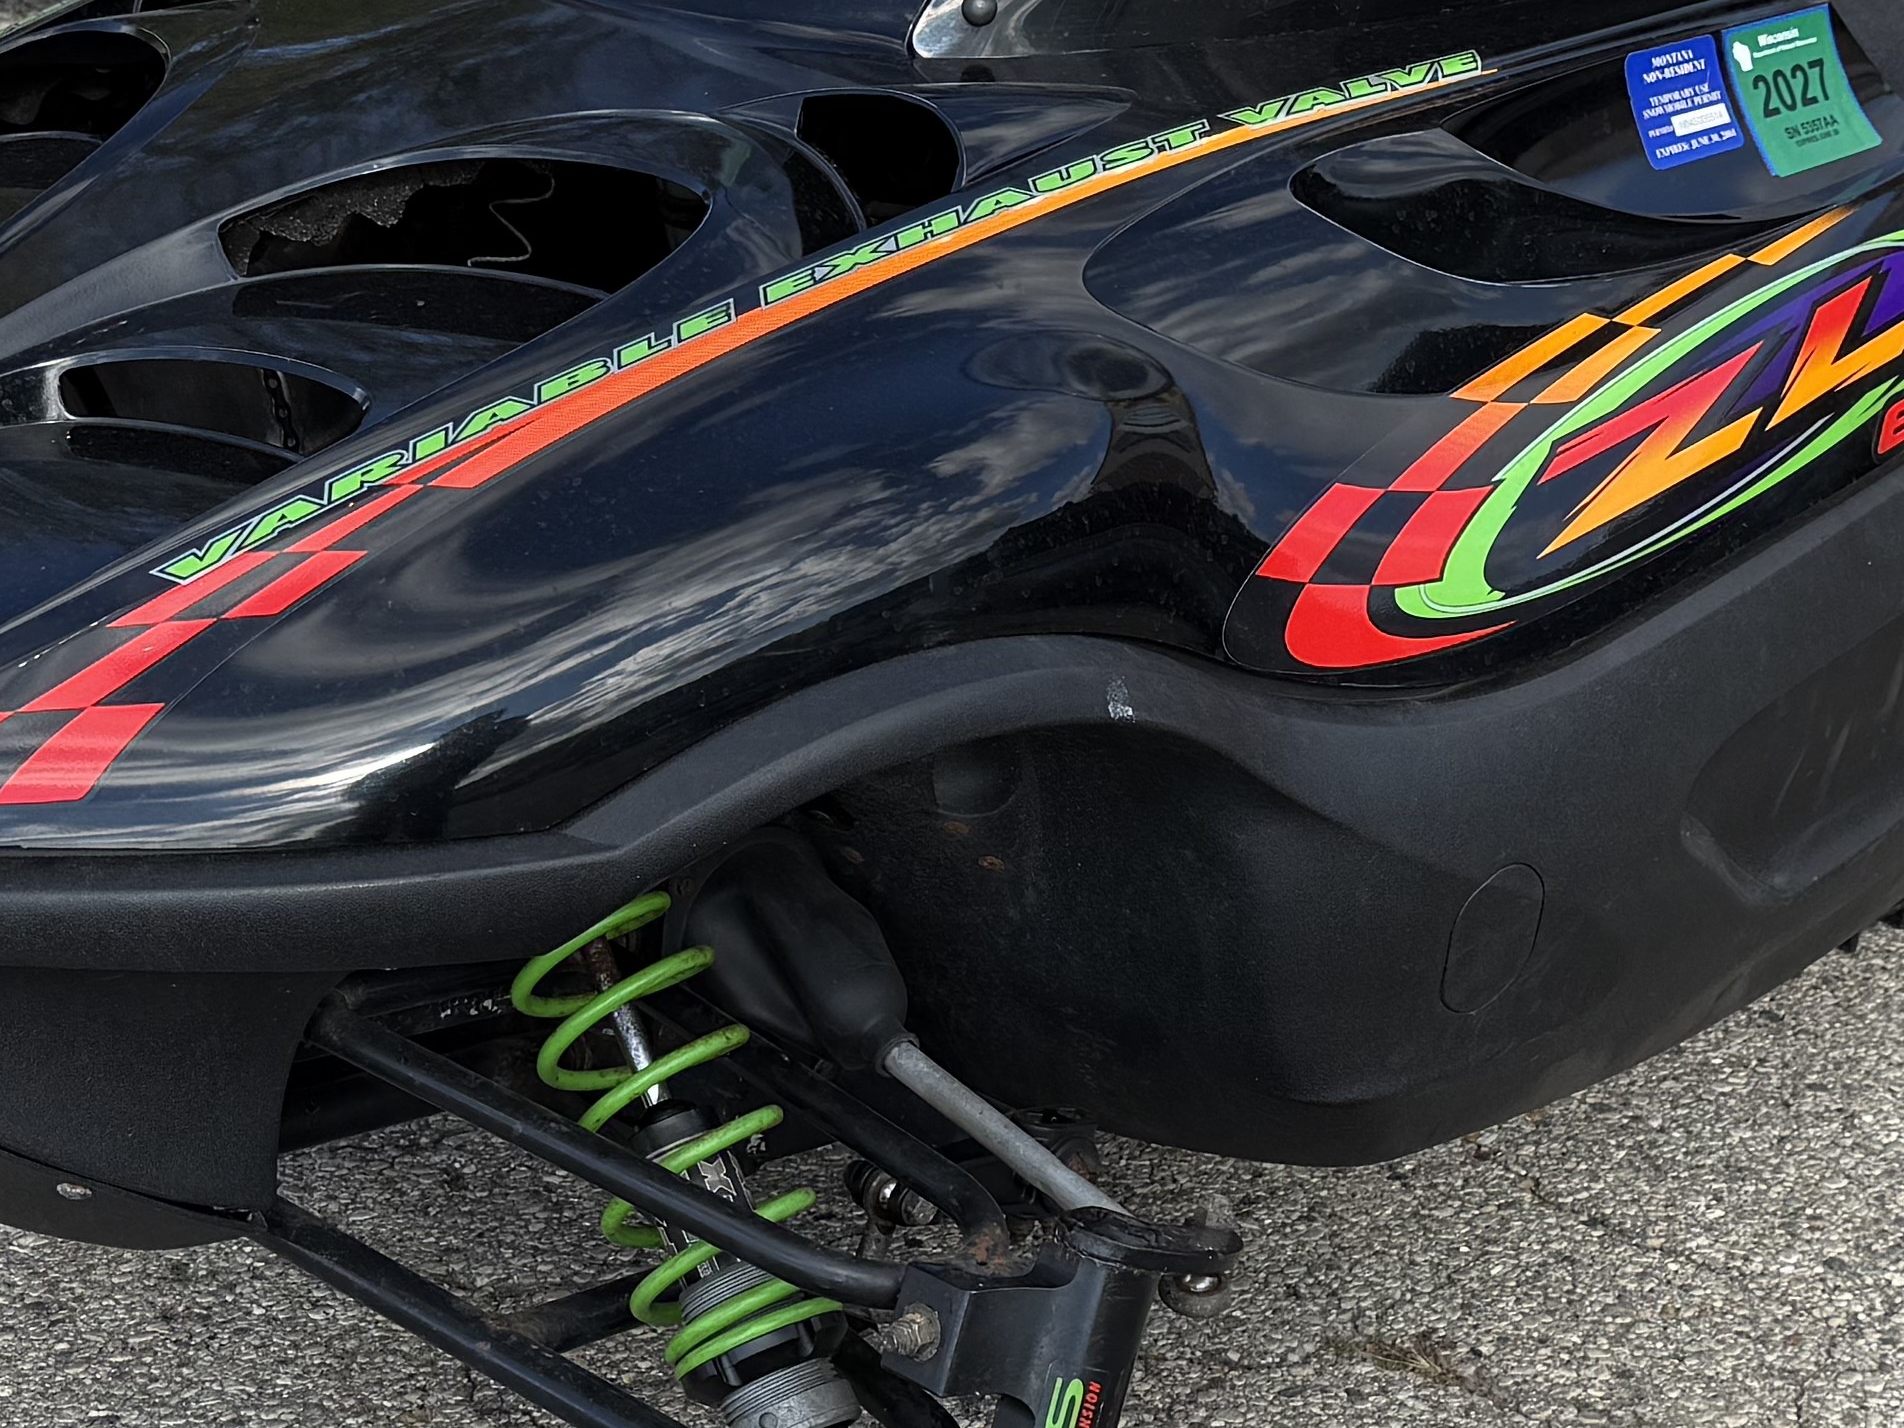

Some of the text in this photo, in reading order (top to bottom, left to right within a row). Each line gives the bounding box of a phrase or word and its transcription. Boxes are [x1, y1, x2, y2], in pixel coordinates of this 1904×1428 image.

[1752, 57, 1830, 119] 2027
[150, 51, 1484, 585] VARIABLE EXHAUST VALVE
